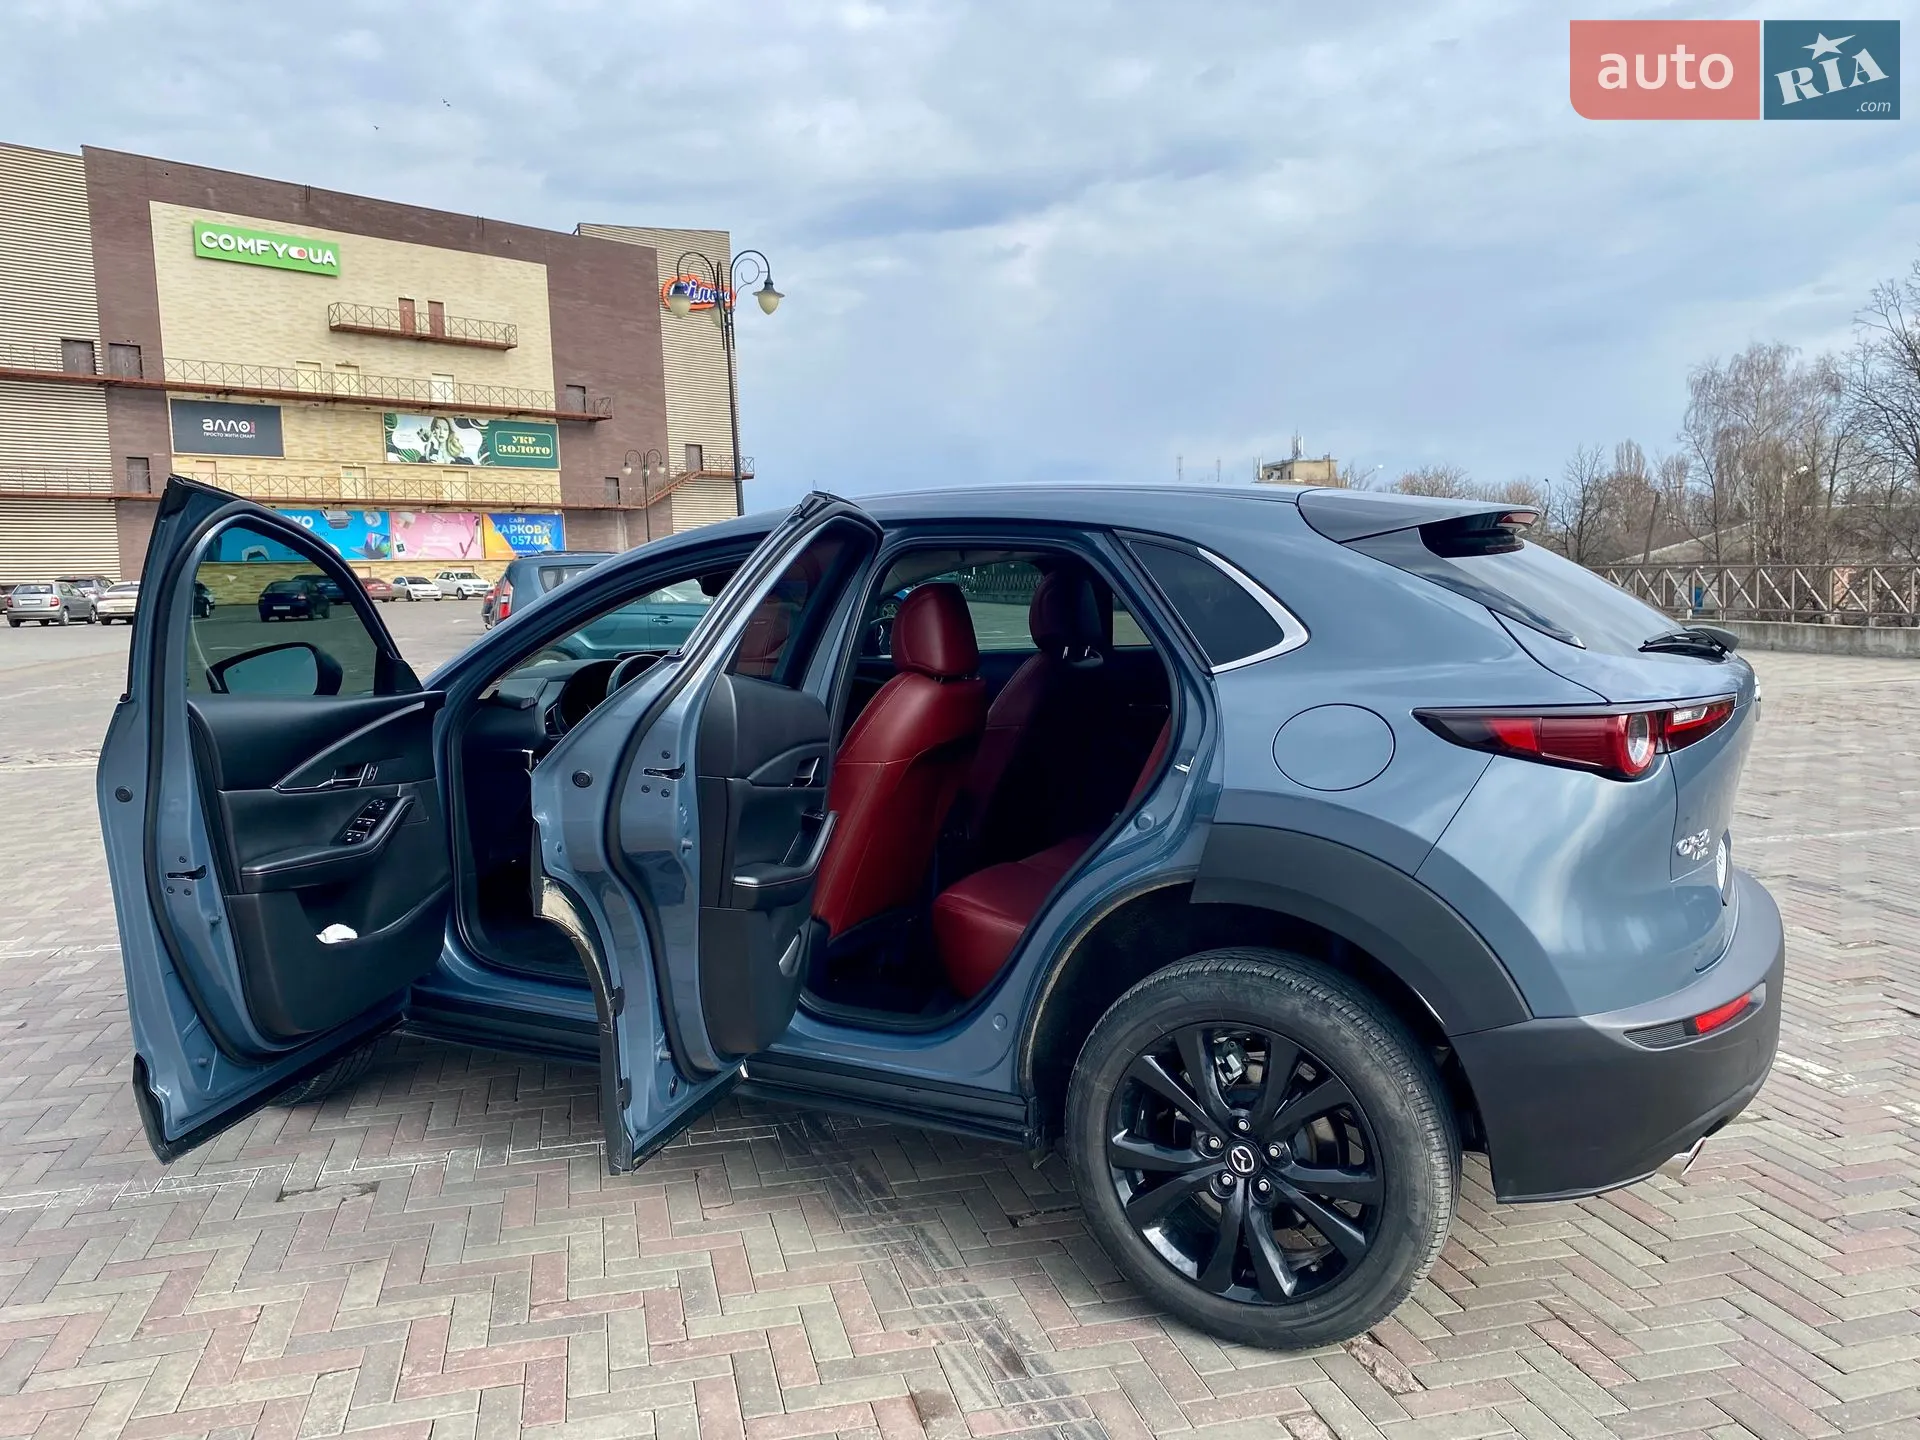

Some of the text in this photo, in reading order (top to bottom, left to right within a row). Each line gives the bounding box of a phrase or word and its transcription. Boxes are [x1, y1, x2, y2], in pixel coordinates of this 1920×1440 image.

[511, 435, 536, 444] УКР
[498, 444, 550, 455] ЗОЛОТО
[508, 516, 526, 524] САЙТ
[510, 535, 550, 546] 057.UA
